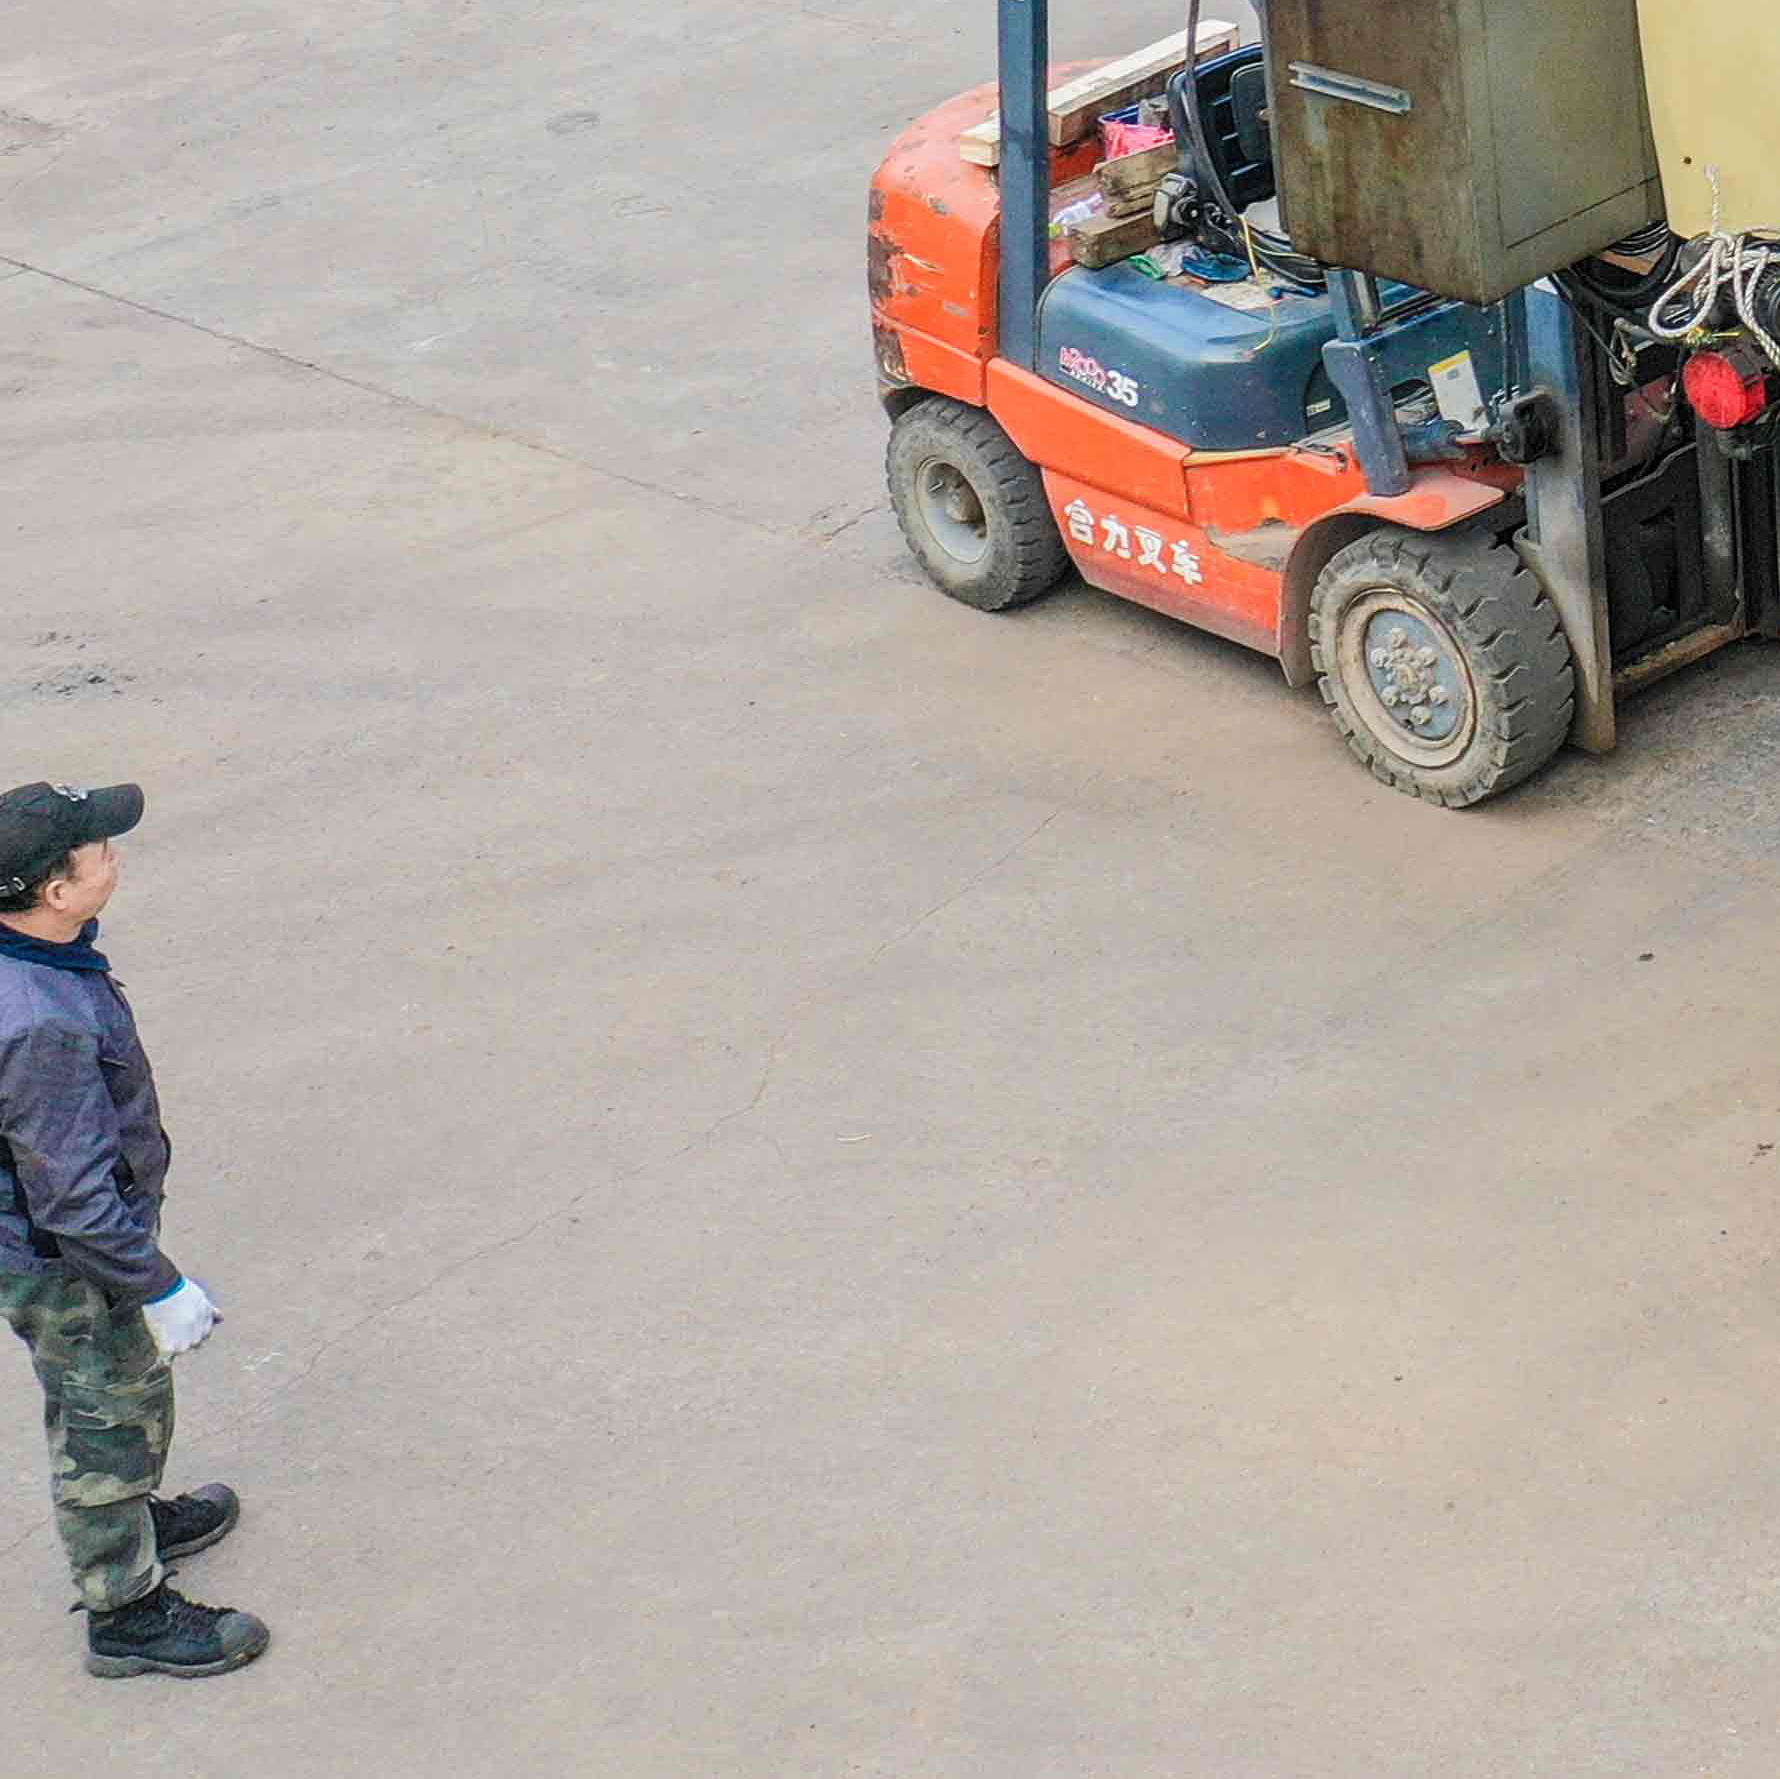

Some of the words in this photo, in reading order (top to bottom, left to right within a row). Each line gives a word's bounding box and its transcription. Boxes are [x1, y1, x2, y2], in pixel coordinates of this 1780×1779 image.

[1106, 370, 1139, 408] 35
[1064, 499, 1206, 585] 合力叉车
